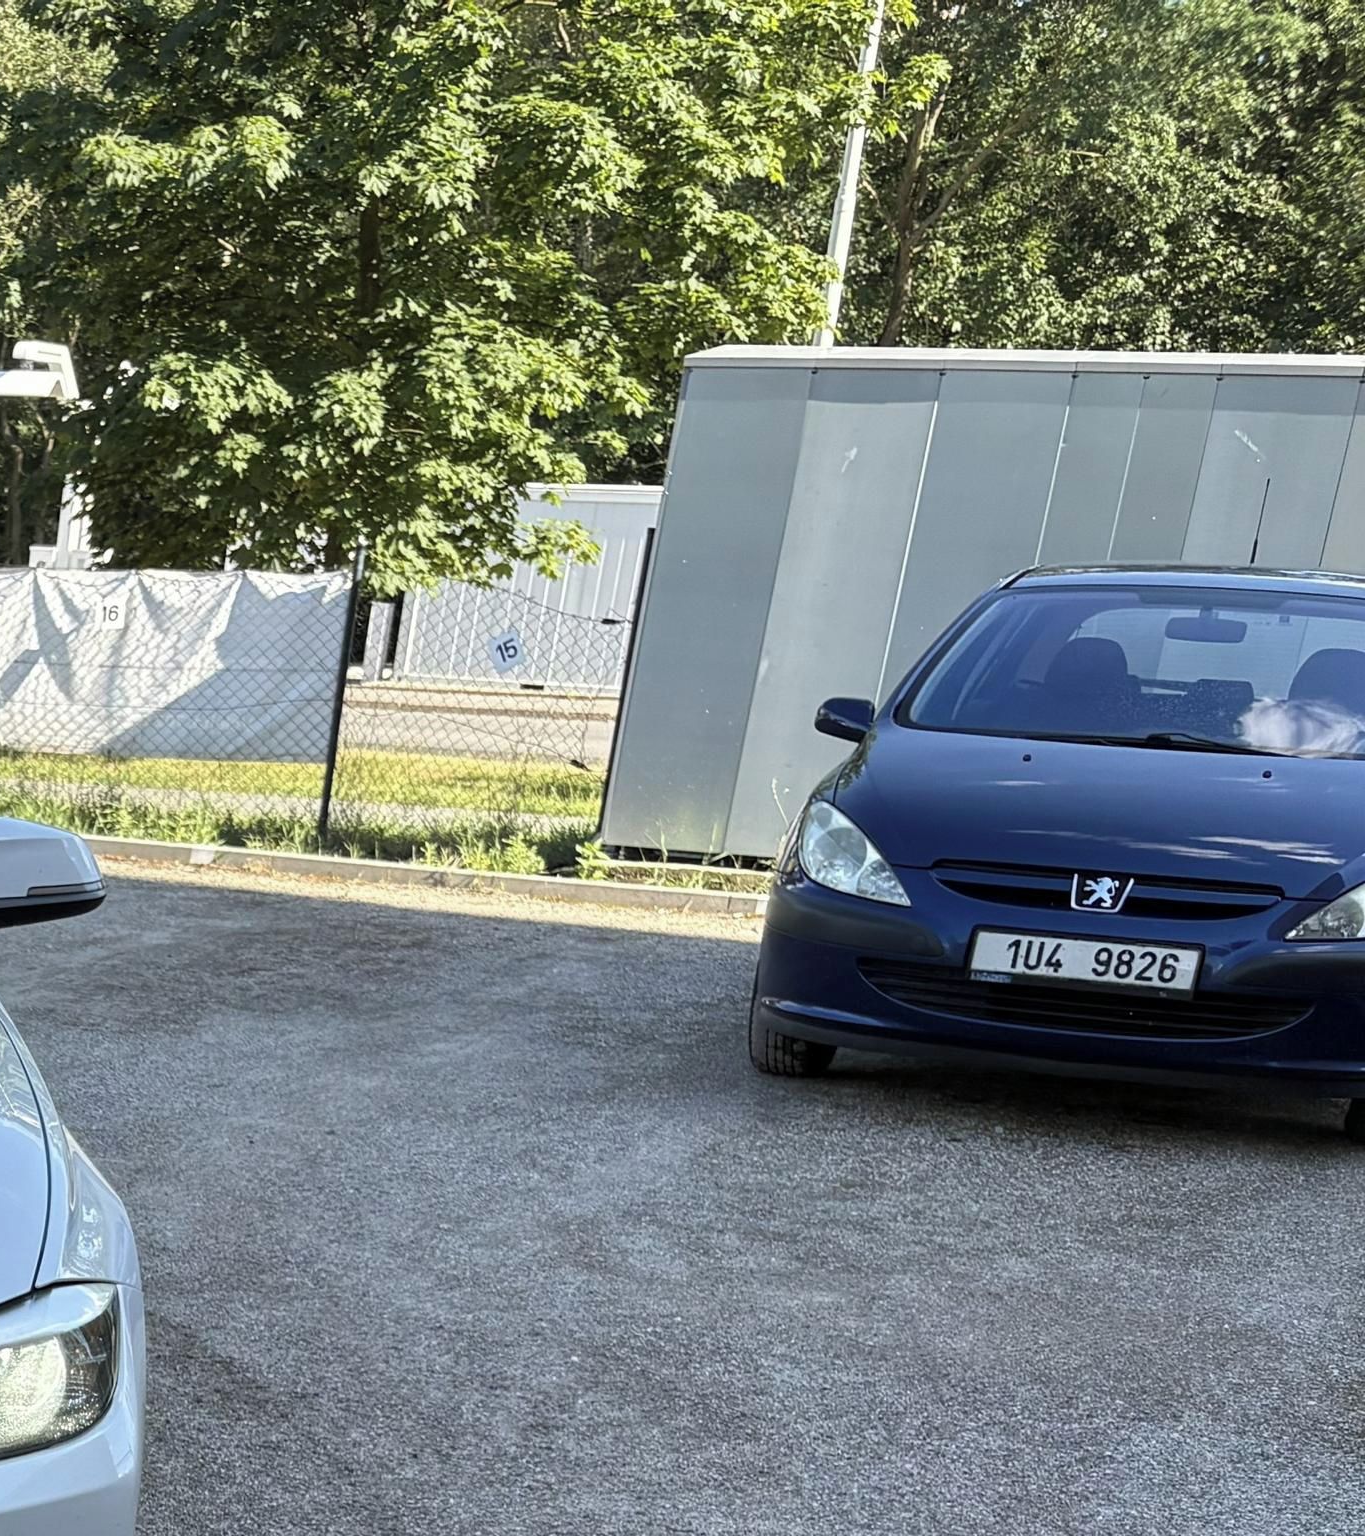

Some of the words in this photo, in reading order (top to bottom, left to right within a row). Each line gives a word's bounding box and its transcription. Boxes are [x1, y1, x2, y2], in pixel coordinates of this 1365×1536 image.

[102, 604, 119, 622] 16
[495, 637, 518, 663] 15
[1006, 939, 1063, 974] 1U4
[1091, 947, 1180, 984] 9826
